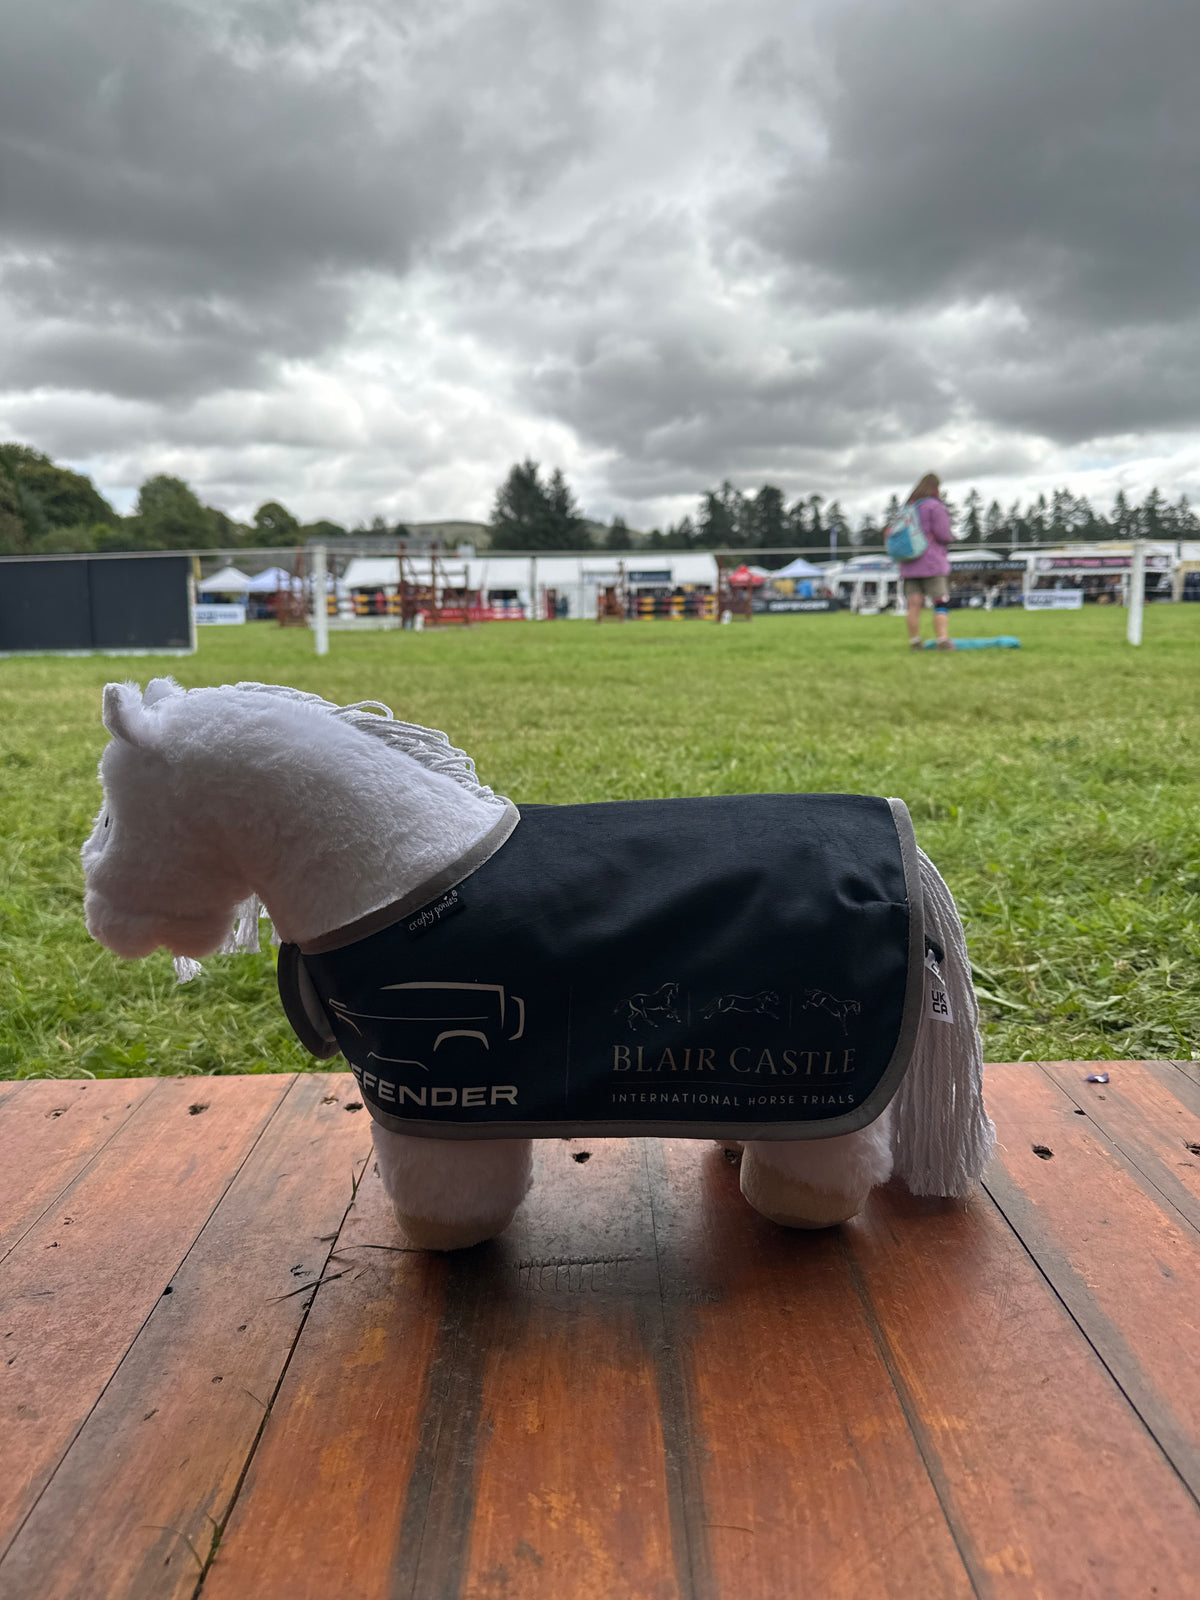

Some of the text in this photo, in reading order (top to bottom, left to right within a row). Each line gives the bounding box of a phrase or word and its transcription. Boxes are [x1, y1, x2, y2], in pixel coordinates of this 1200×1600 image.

[408, 910, 434, 931] crafty
[931, 990, 947, 1004] UK
[932, 1002, 948, 1016] CA
[612, 1045, 856, 1076] BLAIR CASTLE
[350, 1062, 519, 1107] EFENDER
[612, 1093, 855, 1106] INTERNATIONAL HORSE TRIALS
